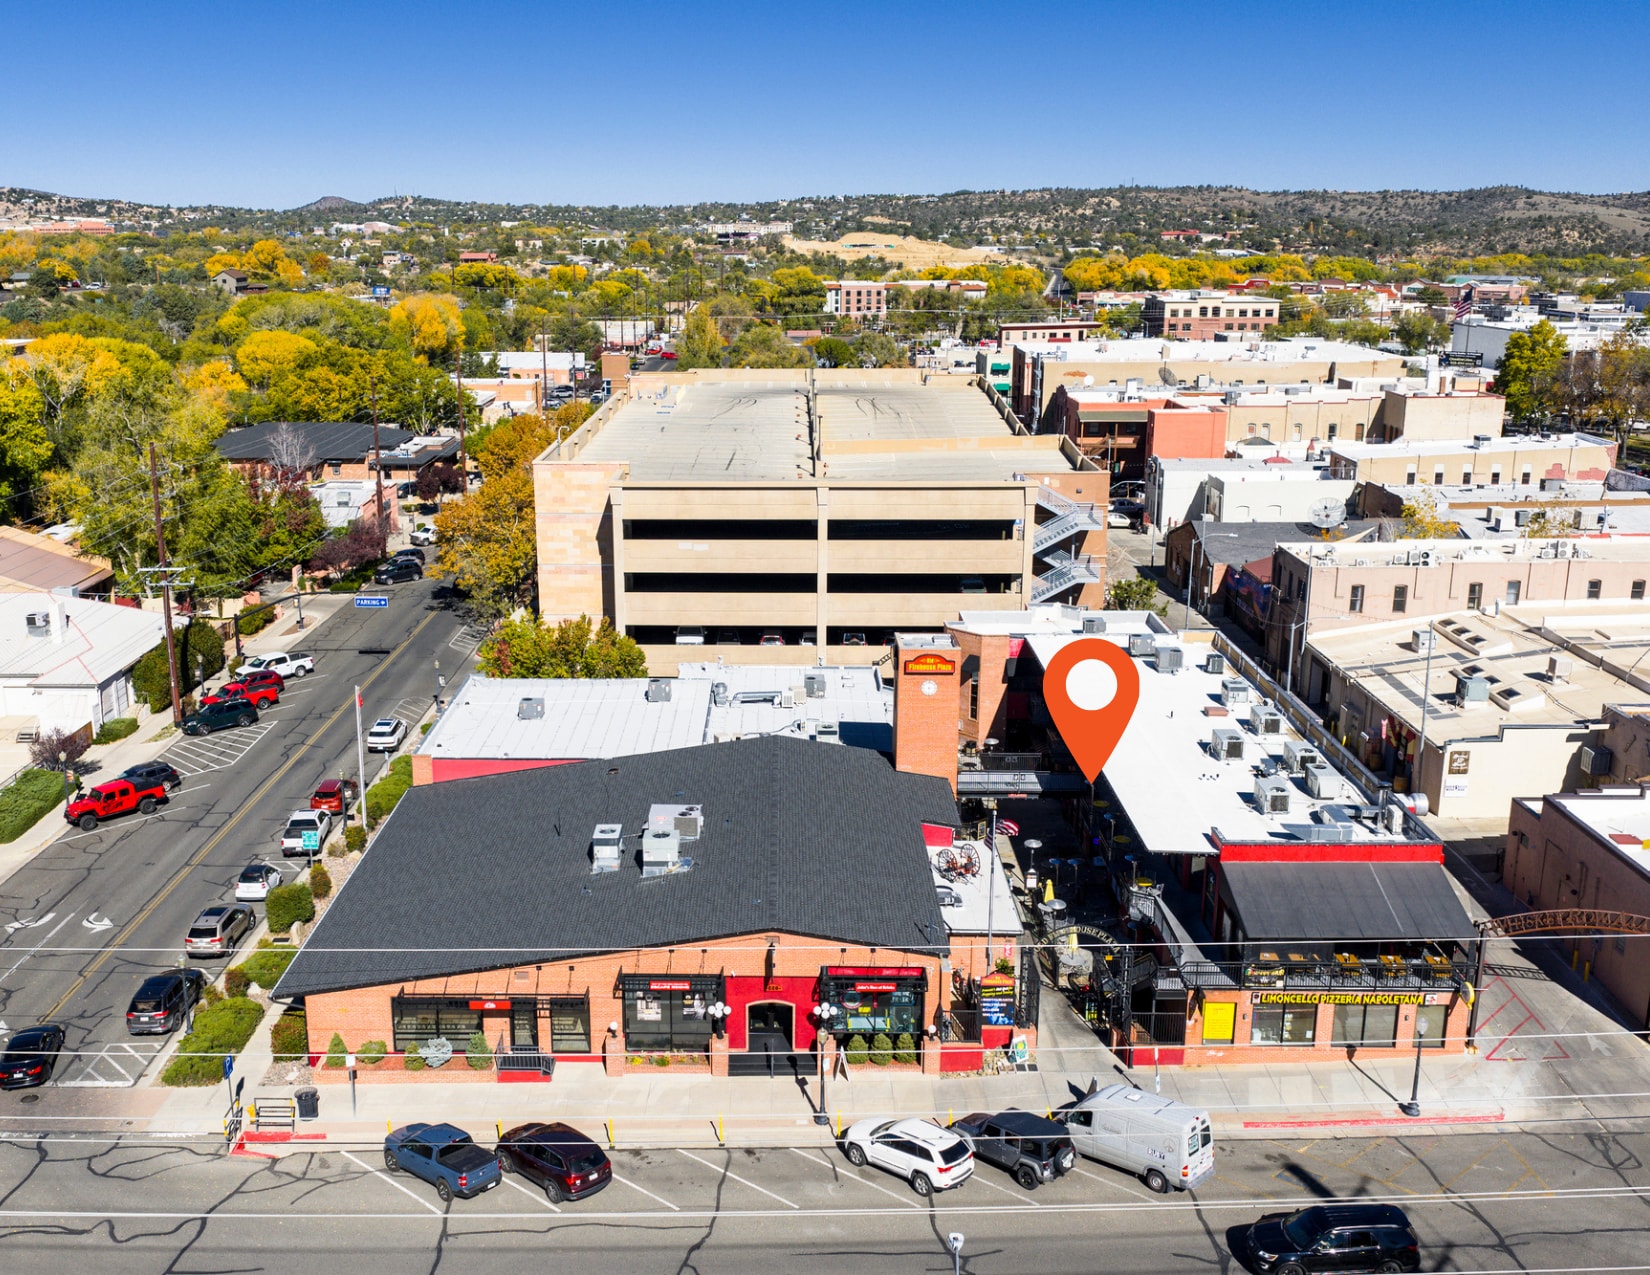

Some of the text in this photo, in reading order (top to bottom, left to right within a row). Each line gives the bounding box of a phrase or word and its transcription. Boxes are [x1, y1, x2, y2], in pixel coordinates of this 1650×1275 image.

[1261, 993, 1424, 1005] LIMONCELLO PIZZERIA NAPOLETANA
[1147, 1147, 1165, 1160] RUBY
